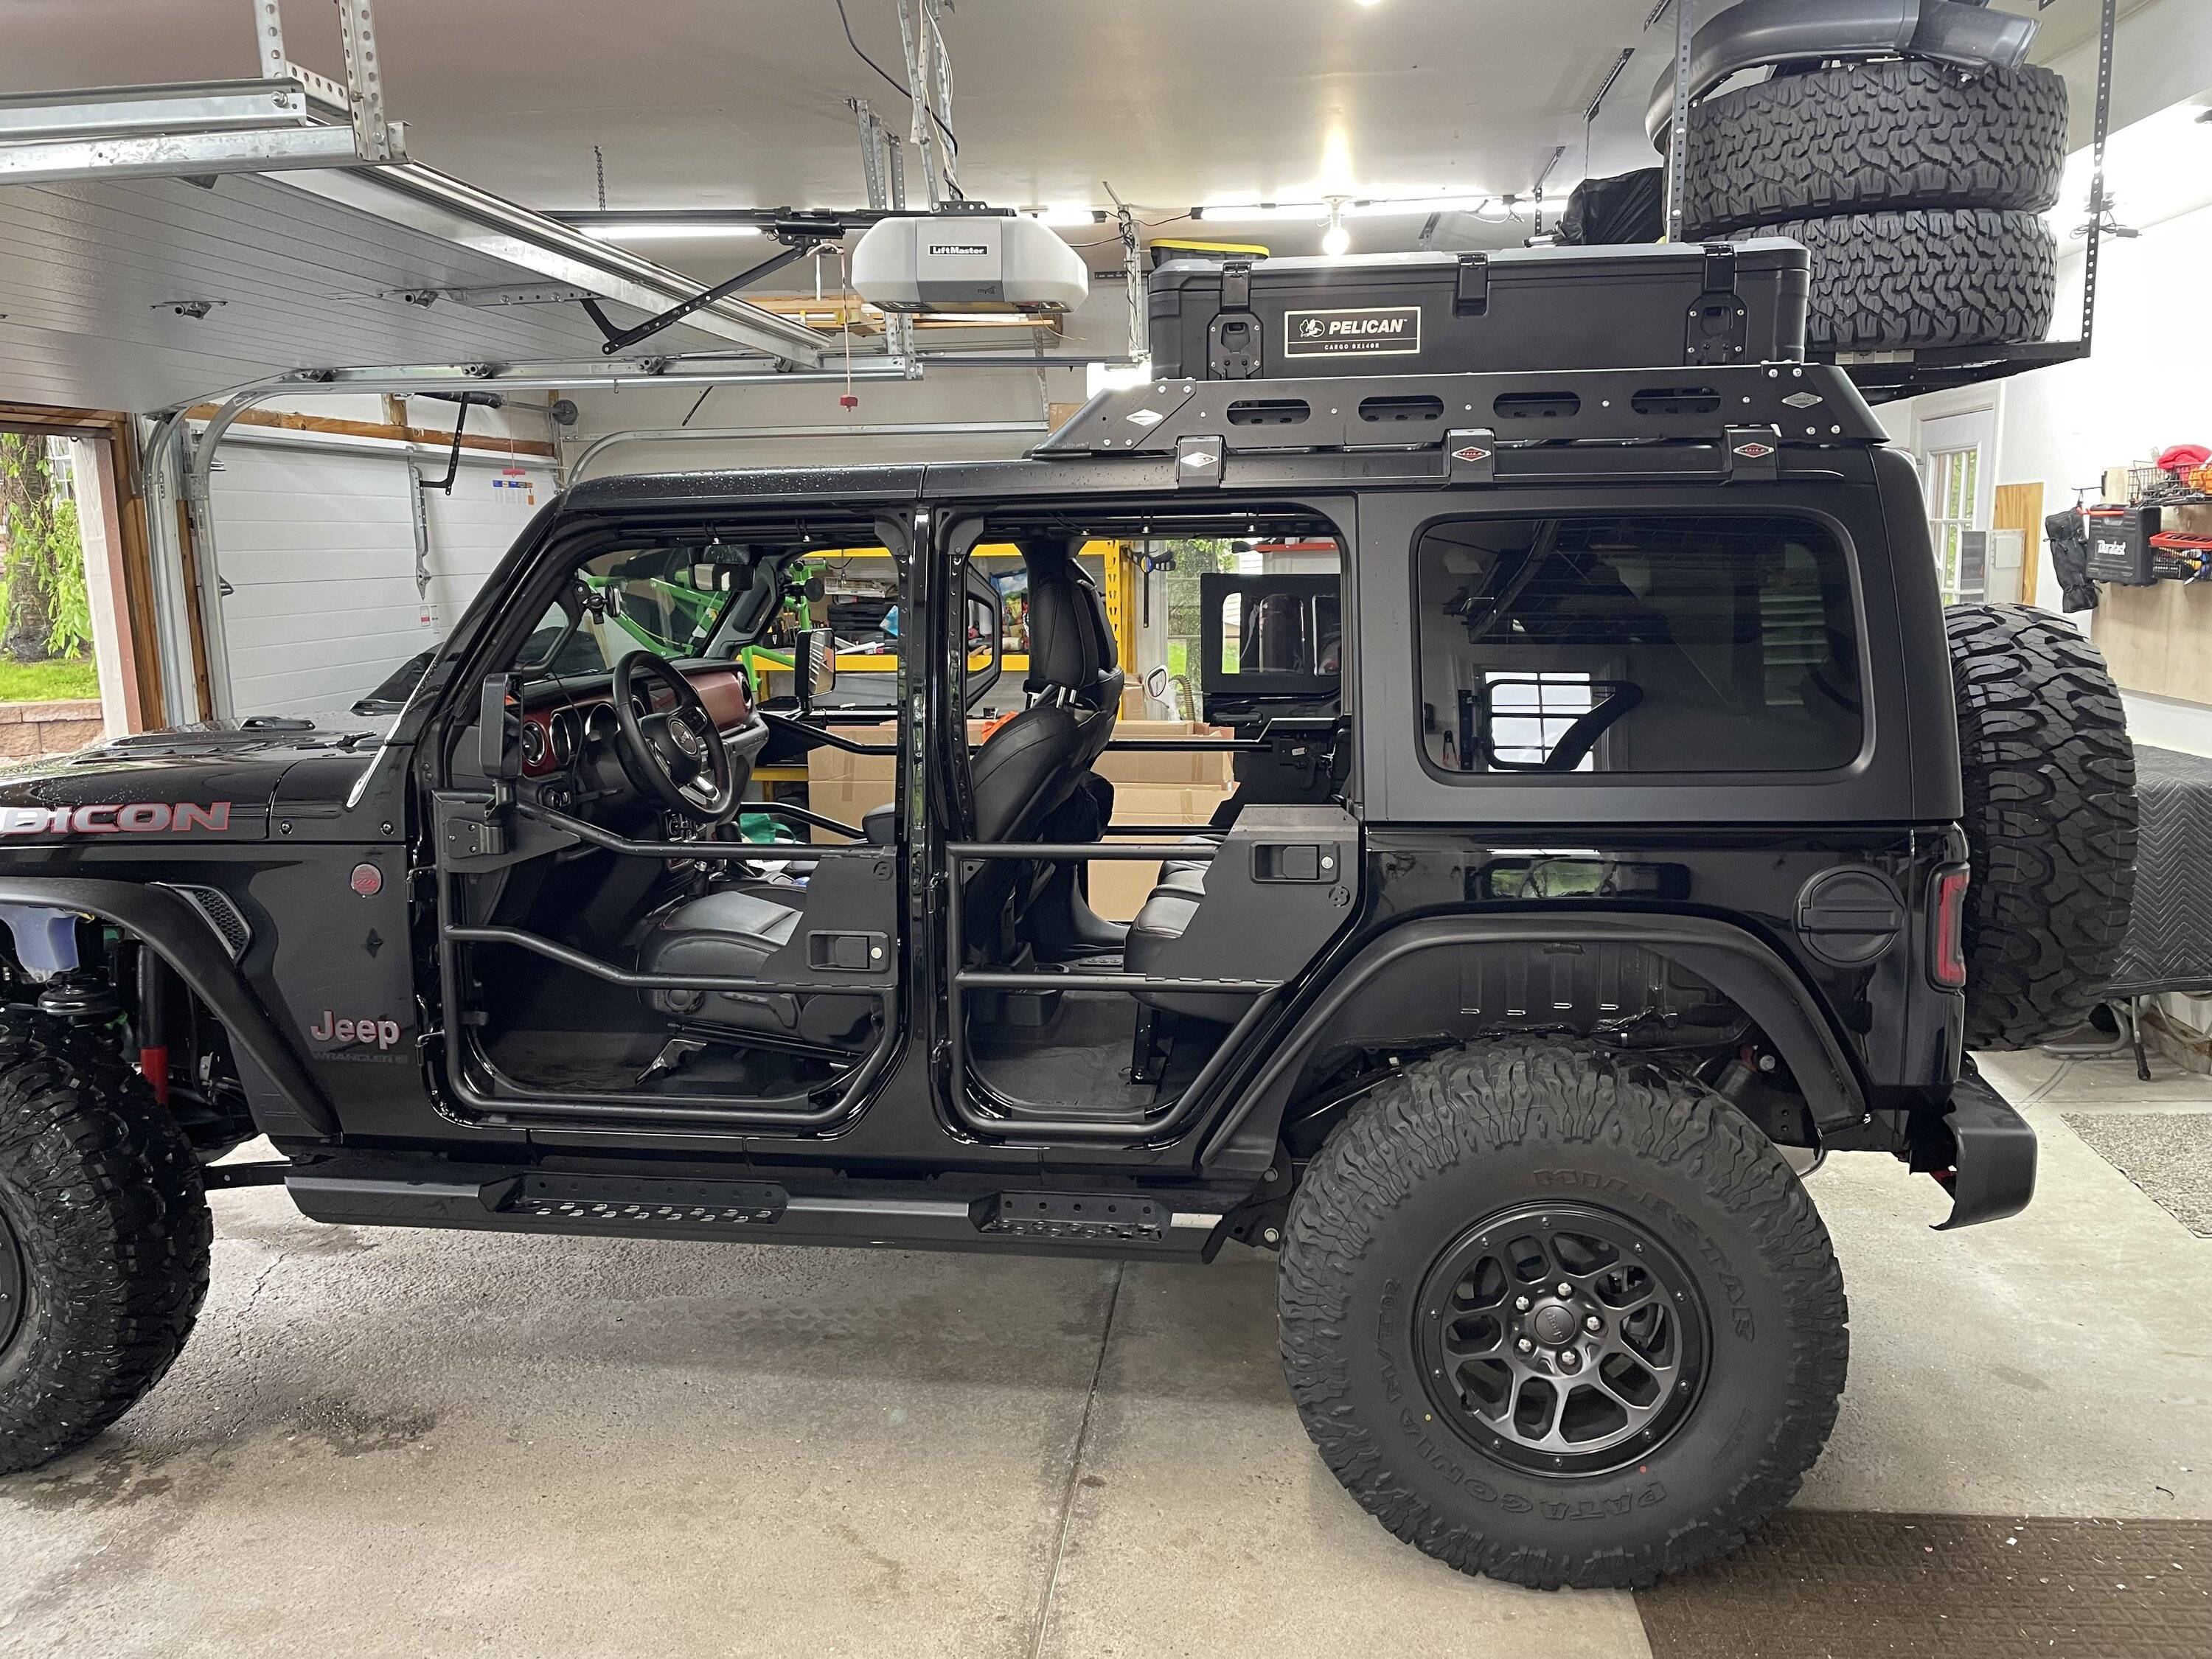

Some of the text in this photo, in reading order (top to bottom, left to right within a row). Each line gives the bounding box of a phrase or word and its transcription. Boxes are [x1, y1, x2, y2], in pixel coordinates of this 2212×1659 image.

[932, 246, 984, 254] LiftMaster
[1328, 319, 1405, 335] PELICAN
[2097, 539, 2126, 555] Duralast
[310, 1010, 400, 1050] Jeep
[1402, 1405, 1667, 1520] PATAGONIA
